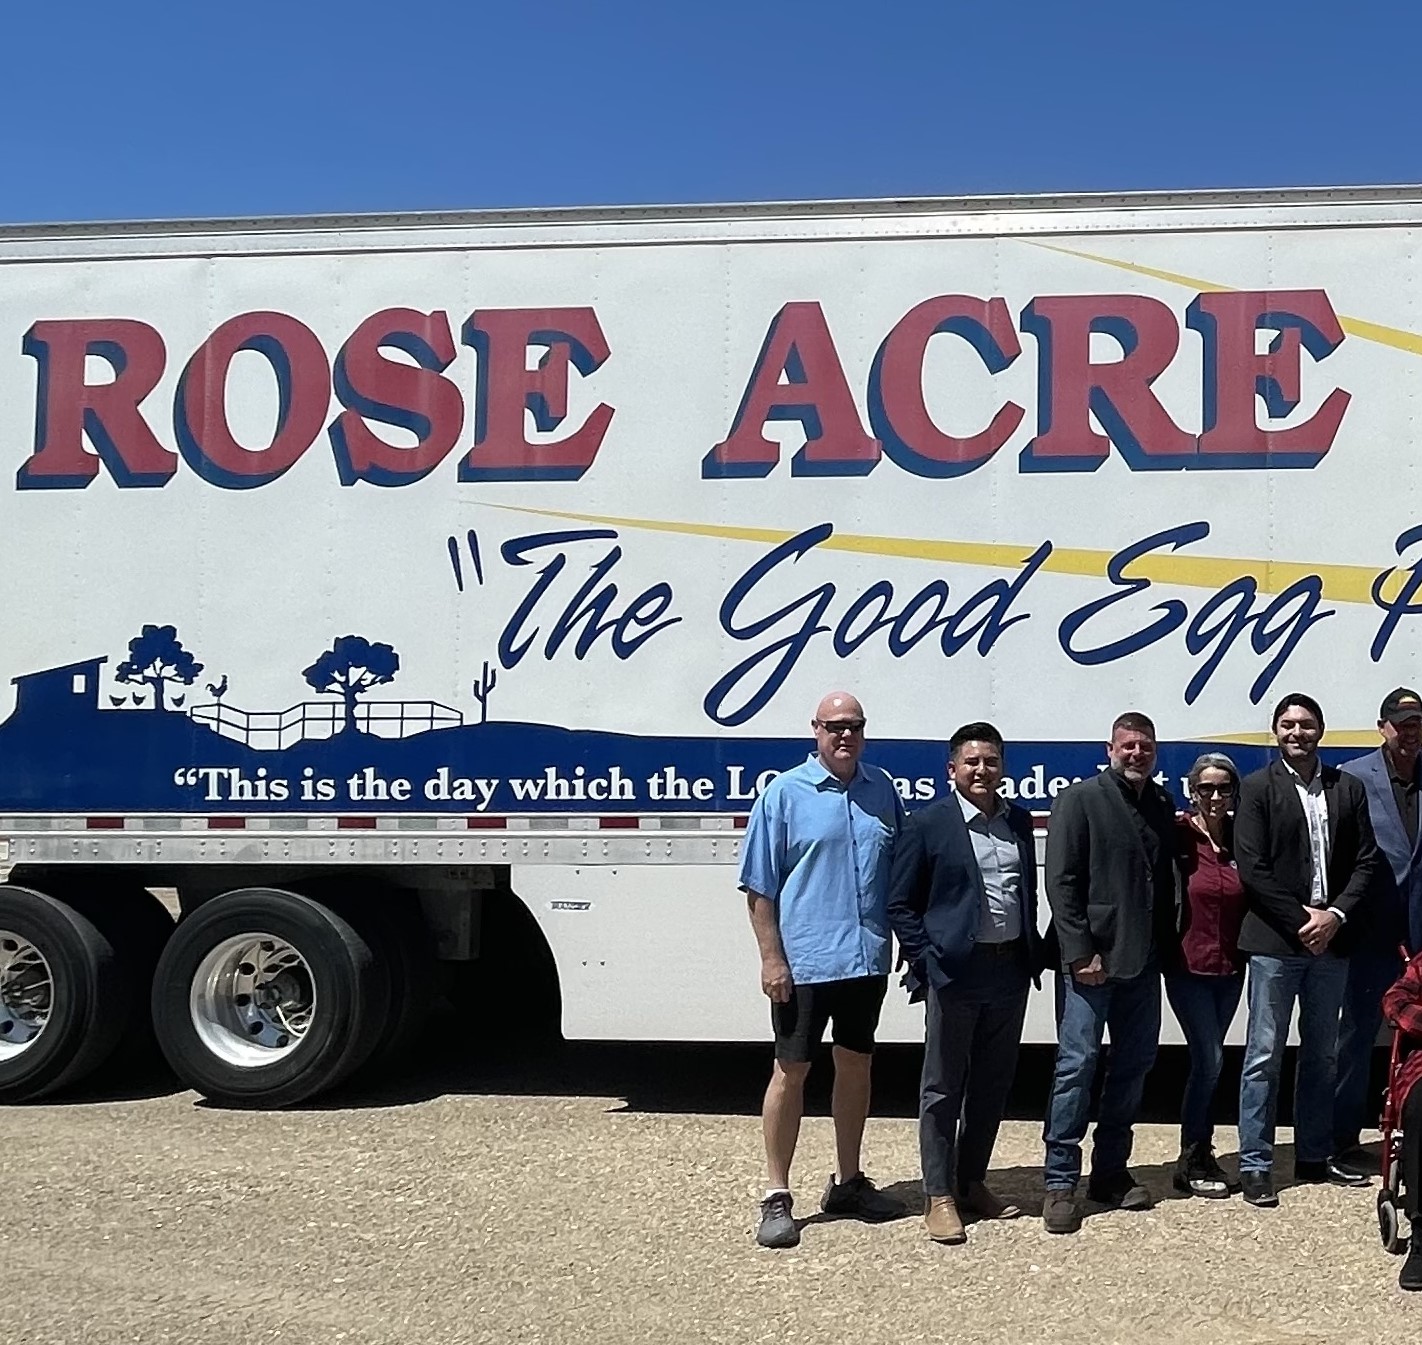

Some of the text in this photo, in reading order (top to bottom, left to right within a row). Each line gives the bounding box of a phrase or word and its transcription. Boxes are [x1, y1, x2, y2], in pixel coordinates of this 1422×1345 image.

[16, 307, 616, 490] ROSE
[701, 289, 1353, 480] ACRE
[703, 522, 1053, 728] Good
[1058, 521, 1336, 706] Egg
[300, 766, 336, 801] is
[346, 766, 412, 801] the
[424, 766, 500, 812] day
[508, 766, 637, 801] which
[646, 766, 714, 801] the
